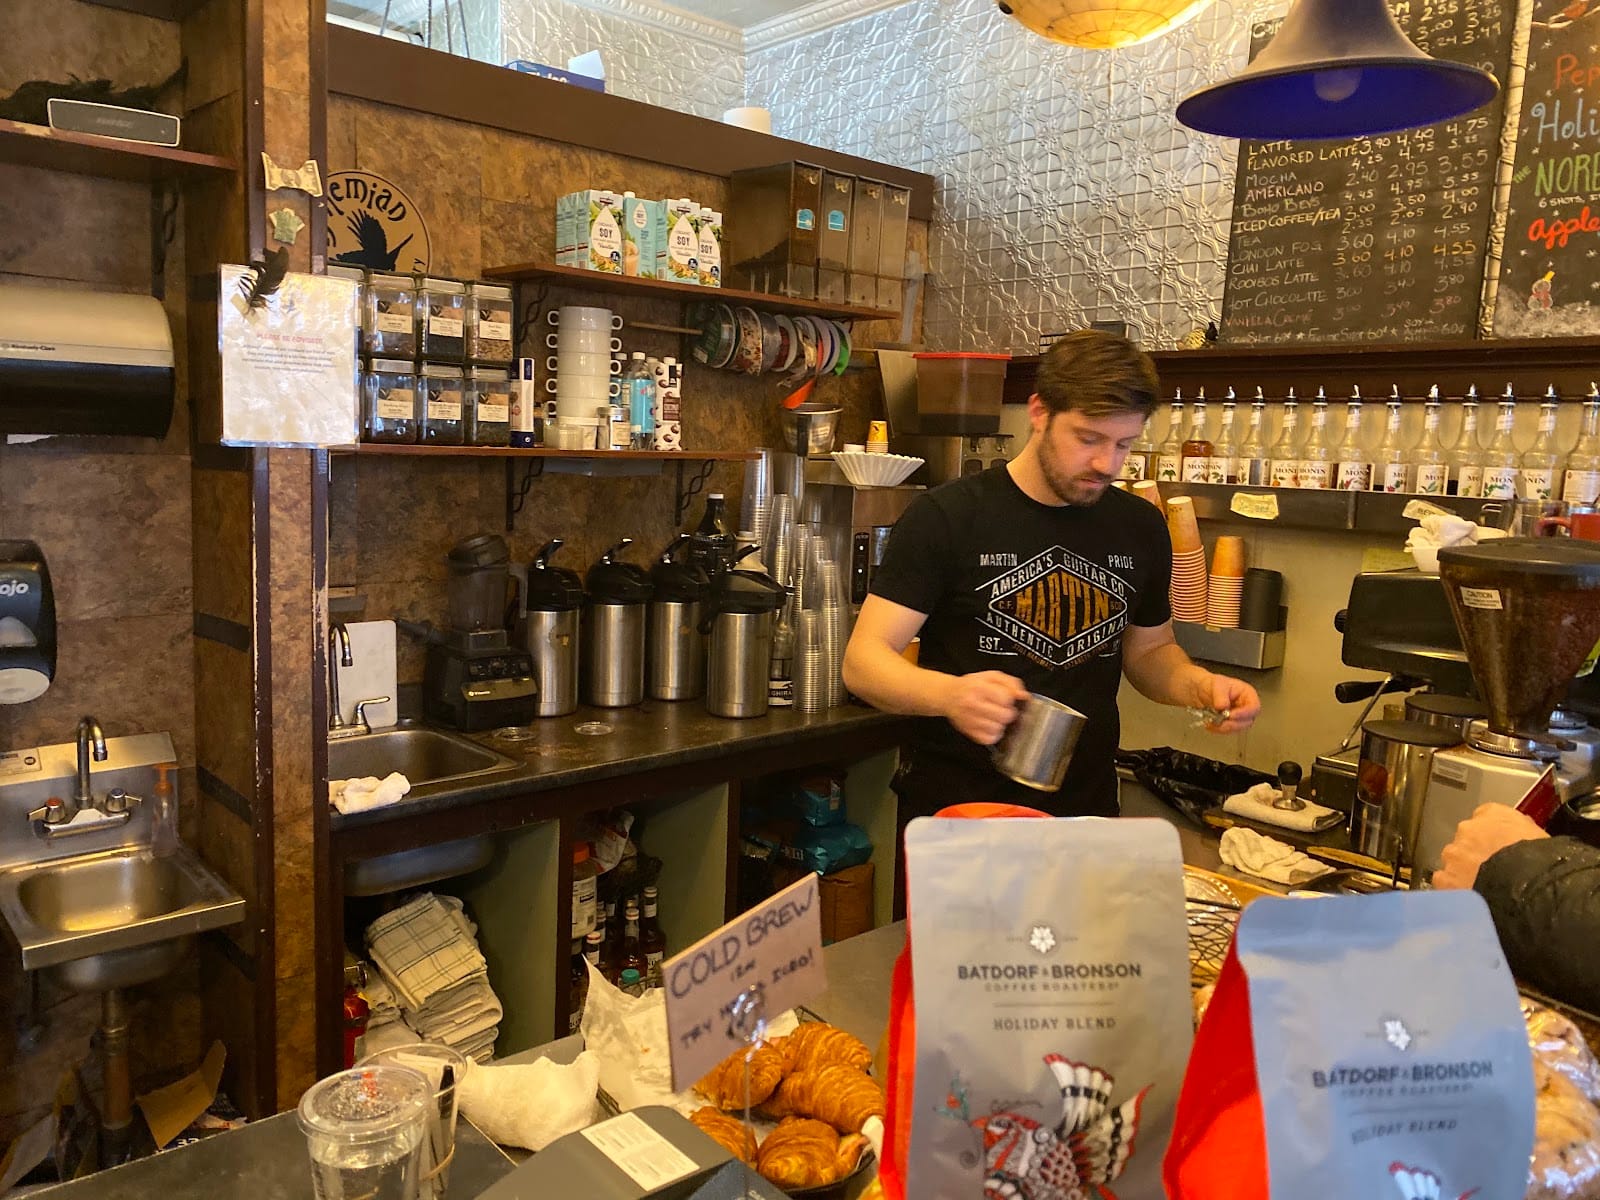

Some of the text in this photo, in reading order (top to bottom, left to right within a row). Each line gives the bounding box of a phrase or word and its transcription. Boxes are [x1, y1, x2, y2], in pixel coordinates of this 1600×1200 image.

[1248, 150, 1314, 171] FLAVORED
[1319, 142, 1359, 160] LATTE
[1446, 117, 1489, 135] 4.75
[1248, 139, 1294, 156] LATTE
[1245, 149, 1488, 202] AMERICANO 2.40 2.95 3.55
[1246, 171, 1297, 187] MOCHA
[1233, 219, 1267, 234] ICED
[1237, 235, 1262, 250] TEA
[1231, 245, 1285, 263] LONDON
[1265, 257, 1305, 272] LATTE
[1284, 272, 1319, 285] LATTE
[979, 553, 1135, 570] MARTIN PRIDE
[990, 553, 1054, 598] AMERICA'S
[1063, 552, 1108, 587] GUITAR
[1015, 571, 1110, 641] MARTIN
[979, 634, 1004, 652] EST.
[986, 611, 1055, 658] AUTHENTIC
[1066, 613, 1130, 658] ORIGINAL
[670, 886, 814, 1000] COLD BREW
[958, 964, 1039, 980] BATDORF
[1051, 963, 1142, 979] BRONSON
[984, 983, 1037, 993] COFFEE
[993, 1017, 1117, 1031] HOLIDAY BLEND
[1312, 1065, 1401, 1089] BATDORF
[1411, 1060, 1494, 1082] BRONSON
[1408, 1118, 1458, 1132] BLEND
